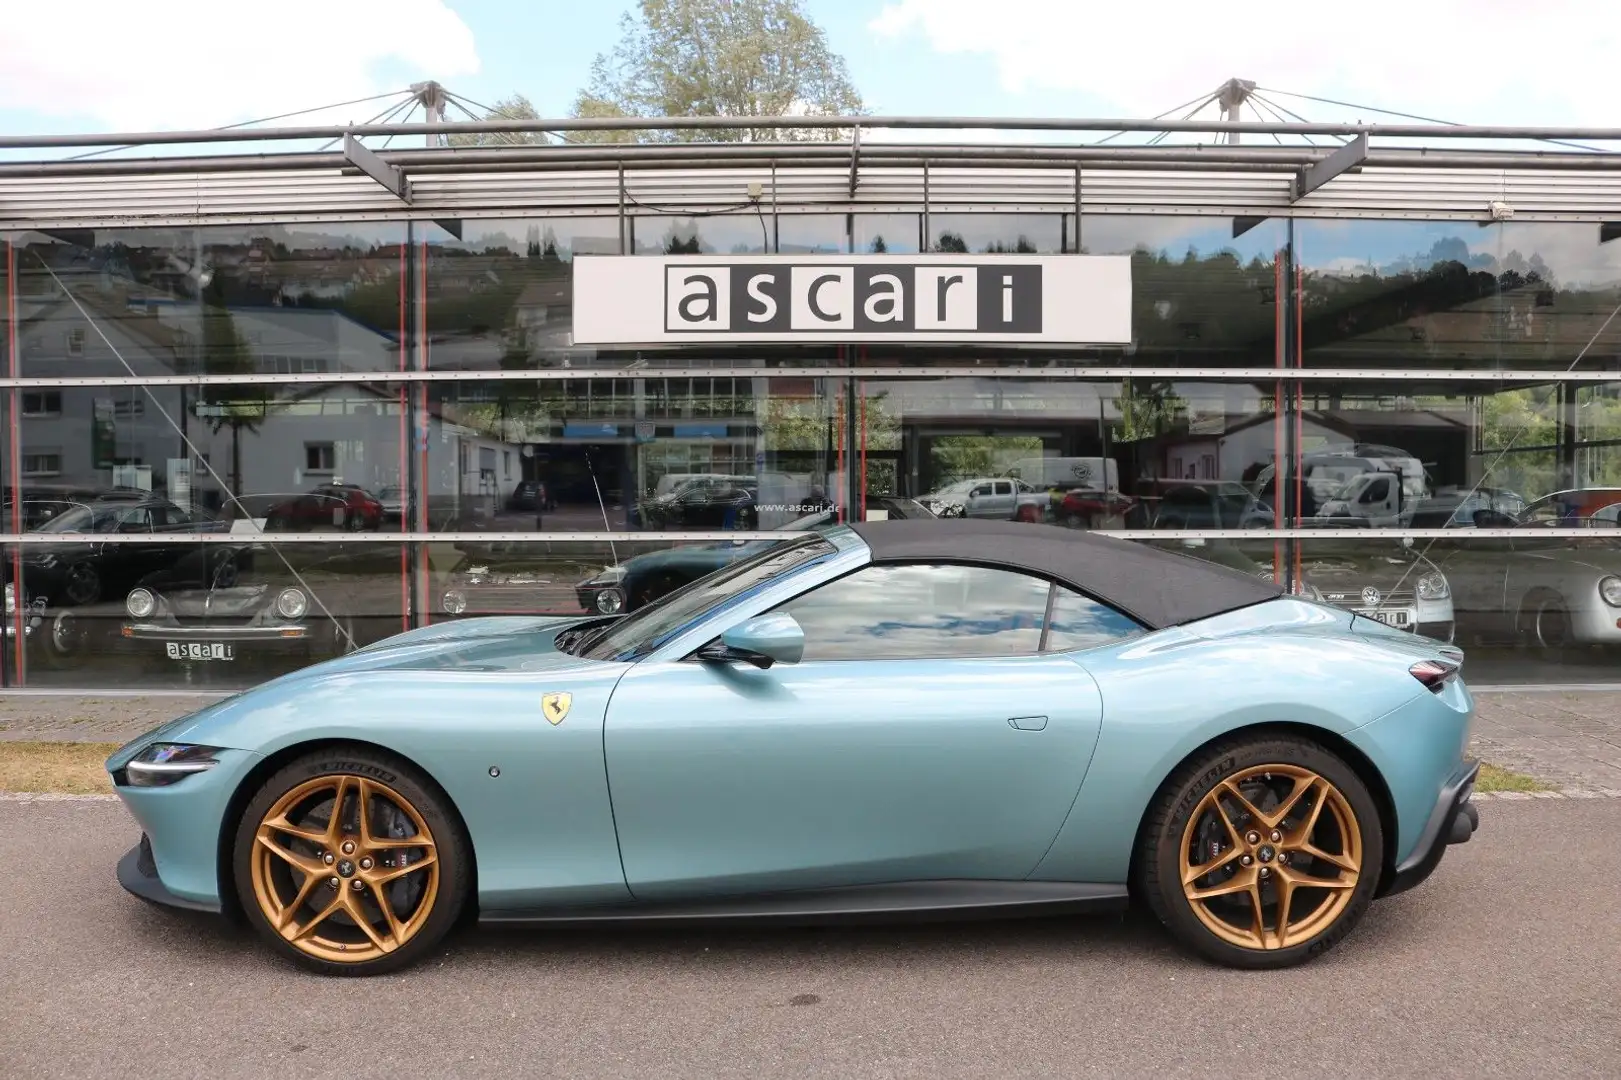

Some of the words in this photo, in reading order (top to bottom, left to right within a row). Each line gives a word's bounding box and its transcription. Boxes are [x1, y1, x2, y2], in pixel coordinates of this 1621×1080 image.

[678, 272, 1013, 324] ascari
[753, 503, 840, 513] www.ascari.de
[167, 643, 232, 658] ascari
